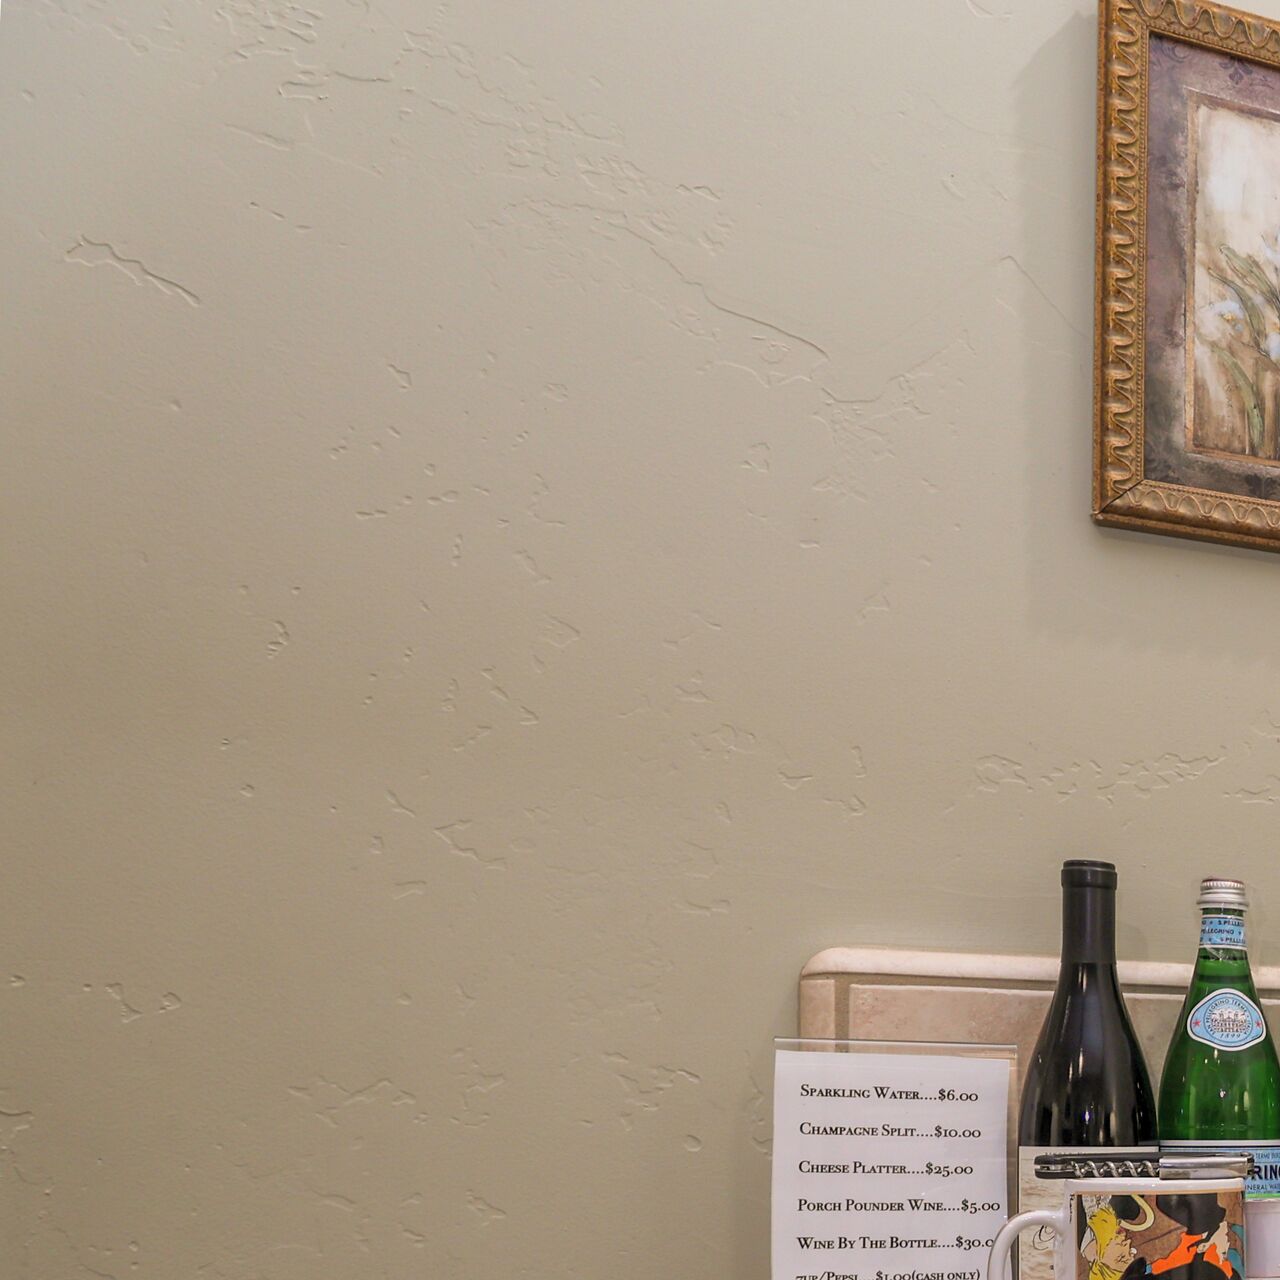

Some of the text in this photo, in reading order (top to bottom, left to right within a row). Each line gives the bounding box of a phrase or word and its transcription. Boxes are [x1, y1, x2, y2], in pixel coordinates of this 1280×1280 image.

[800, 1084, 870, 1098] SPARKLING
[800, 1122, 878, 1137] CHAMPAGNE
[798, 1160, 850, 1174] CHEESE
[798, 1198, 842, 1212] PORCH
[846, 1198, 904, 1212] POUNDER
[796, 1236, 994, 1251] WINE BY THE BOTTLE....$30.0
